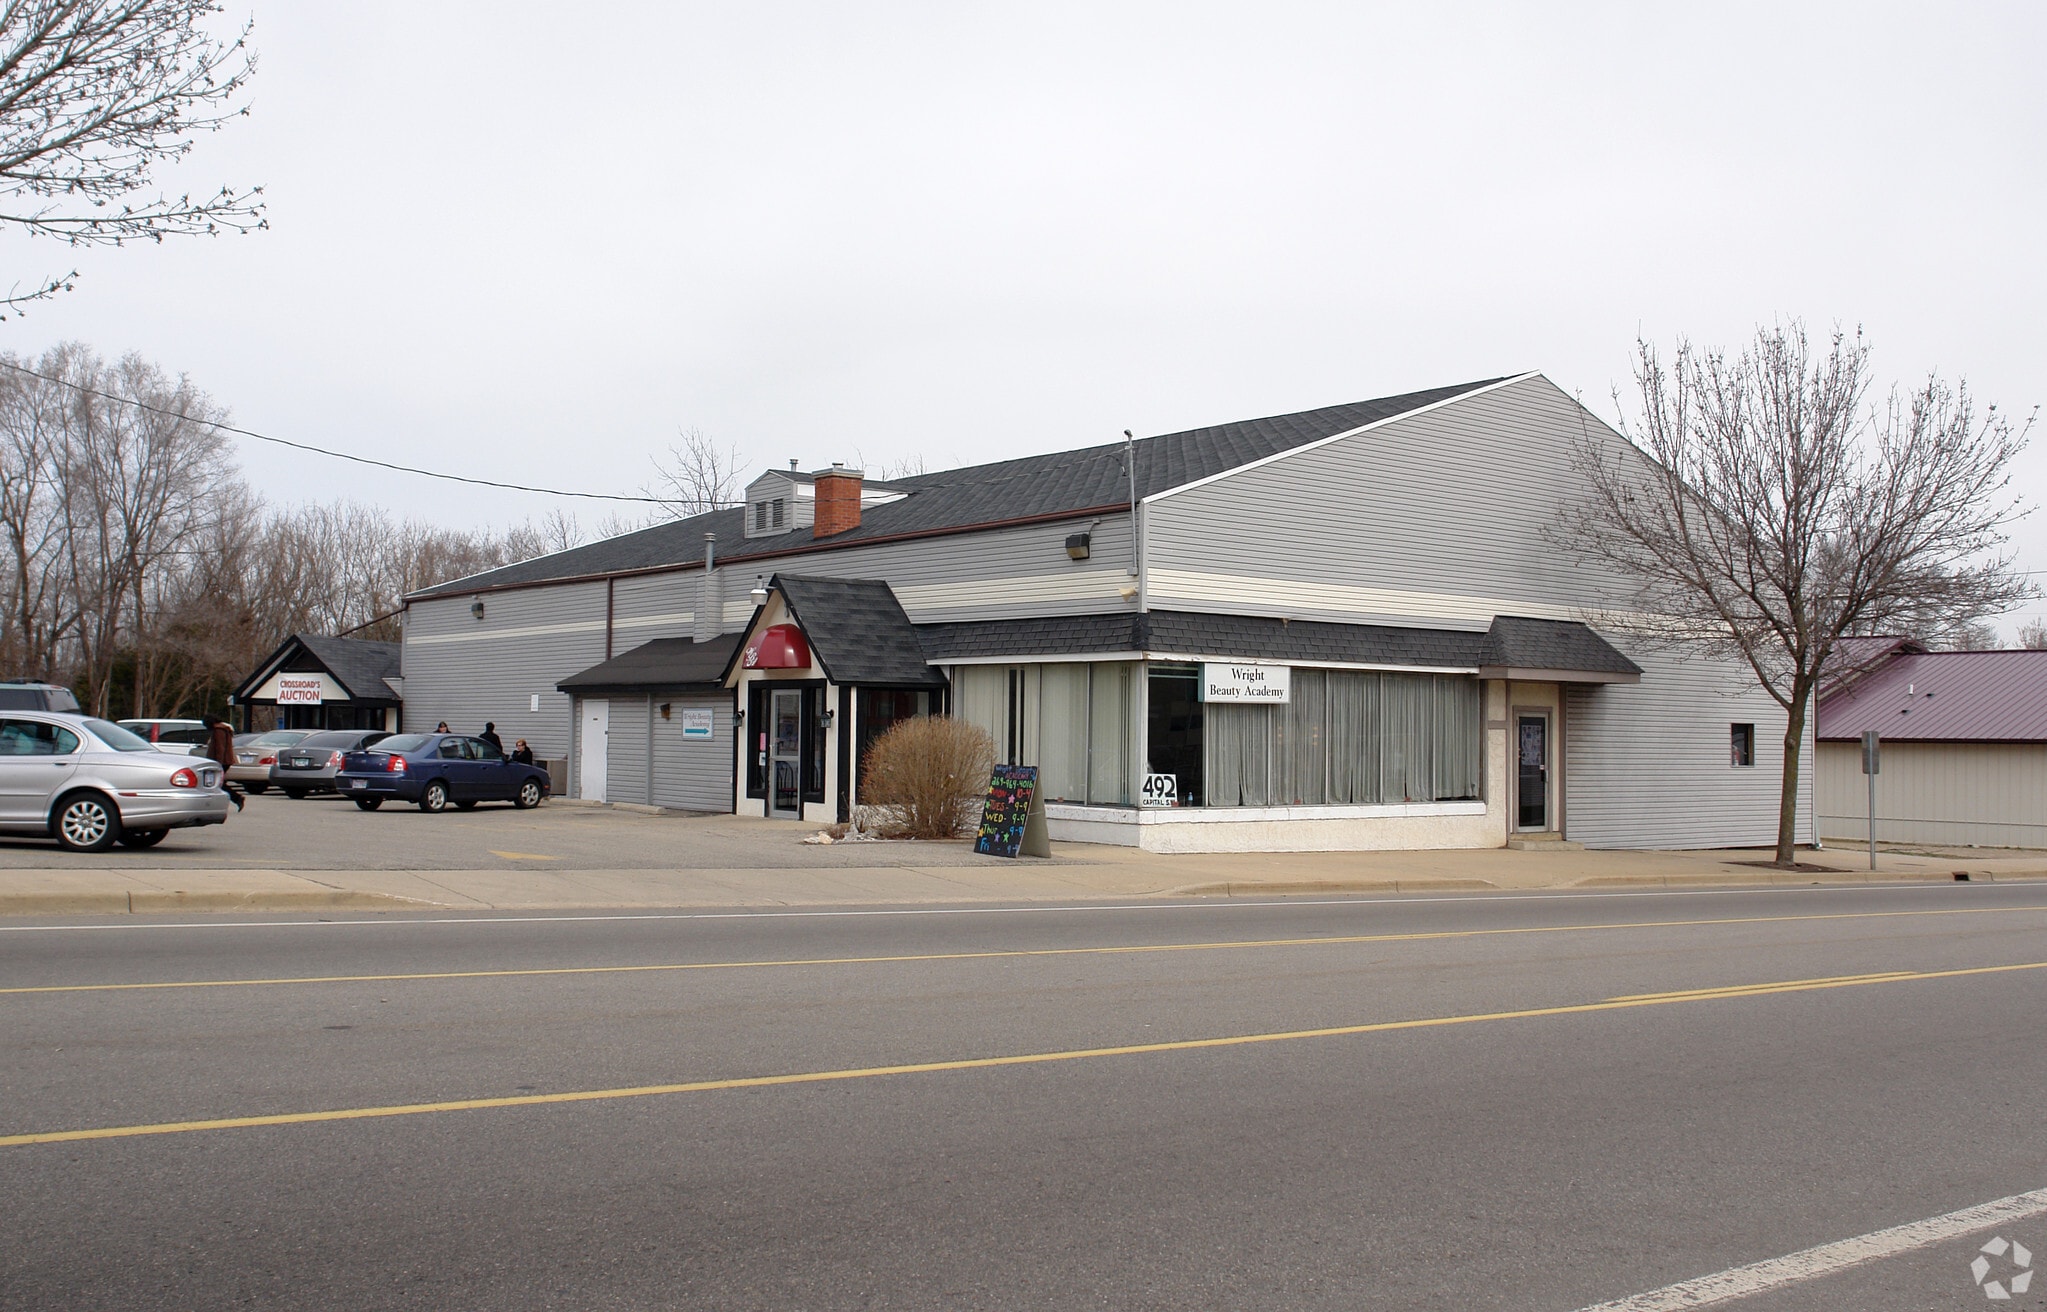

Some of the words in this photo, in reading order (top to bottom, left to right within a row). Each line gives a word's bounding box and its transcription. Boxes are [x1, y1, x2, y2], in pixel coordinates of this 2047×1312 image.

[1231, 667, 1265, 683] Wright
[280, 690, 320, 701] AUCTION
[1210, 684, 1241, 698] Beauty
[1244, 685, 1285, 699] Academy
[1142, 775, 1176, 798] 492
